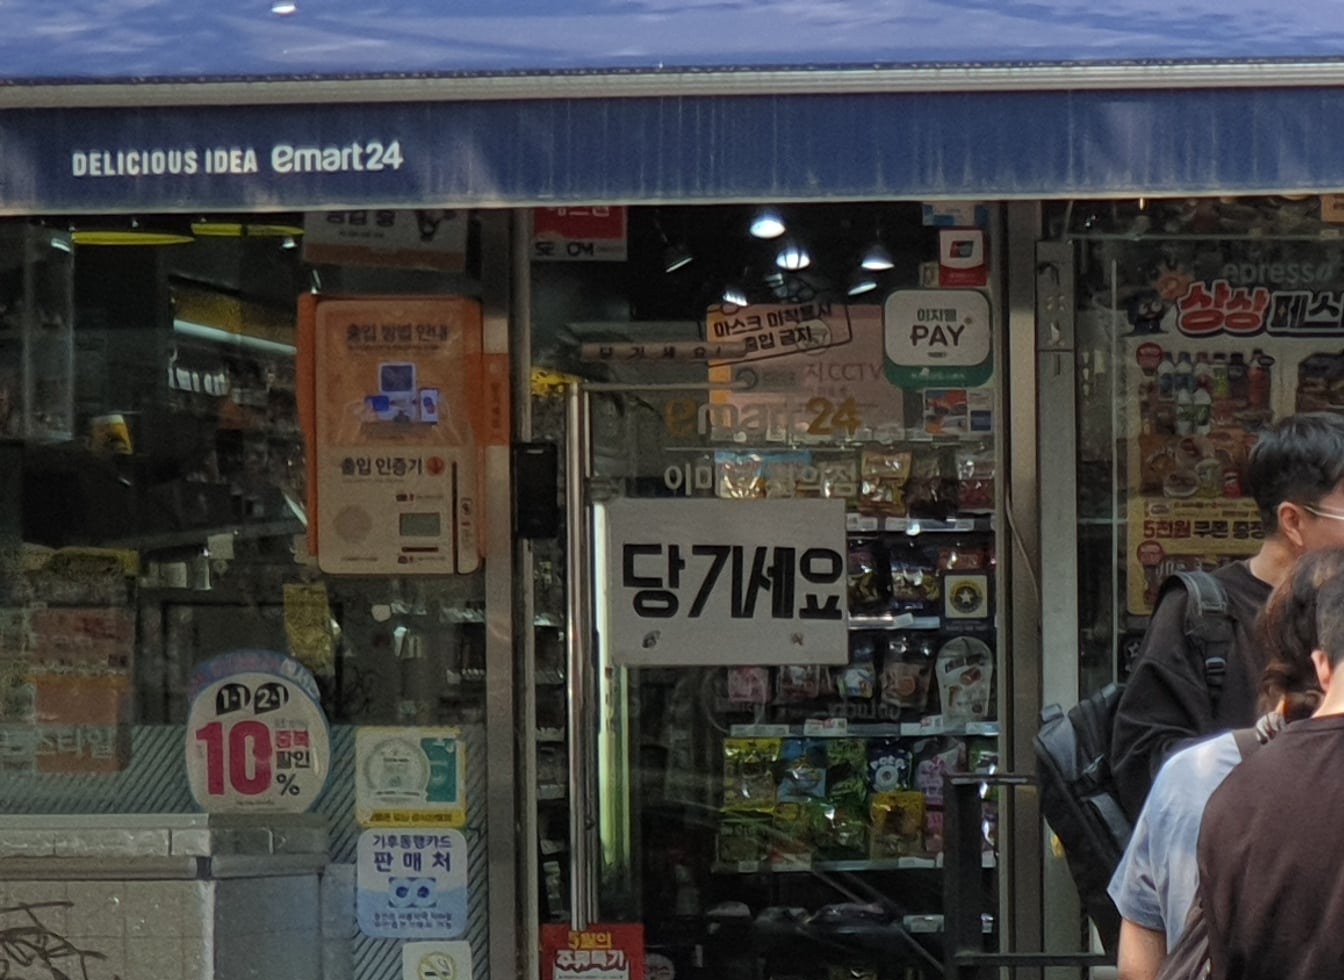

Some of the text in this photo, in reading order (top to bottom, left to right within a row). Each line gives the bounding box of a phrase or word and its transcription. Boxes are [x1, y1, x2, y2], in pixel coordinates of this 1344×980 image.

[72, 140, 403, 176] DELICIOUS IDEA emart24
[1177, 280, 1268, 333] 상상
[712, 314, 768, 338] 마스크
[911, 325, 964, 346] PAY
[623, 543, 844, 620] 당기세요
[196, 721, 272, 796] 10
[374, 852, 451, 873] 판매처
